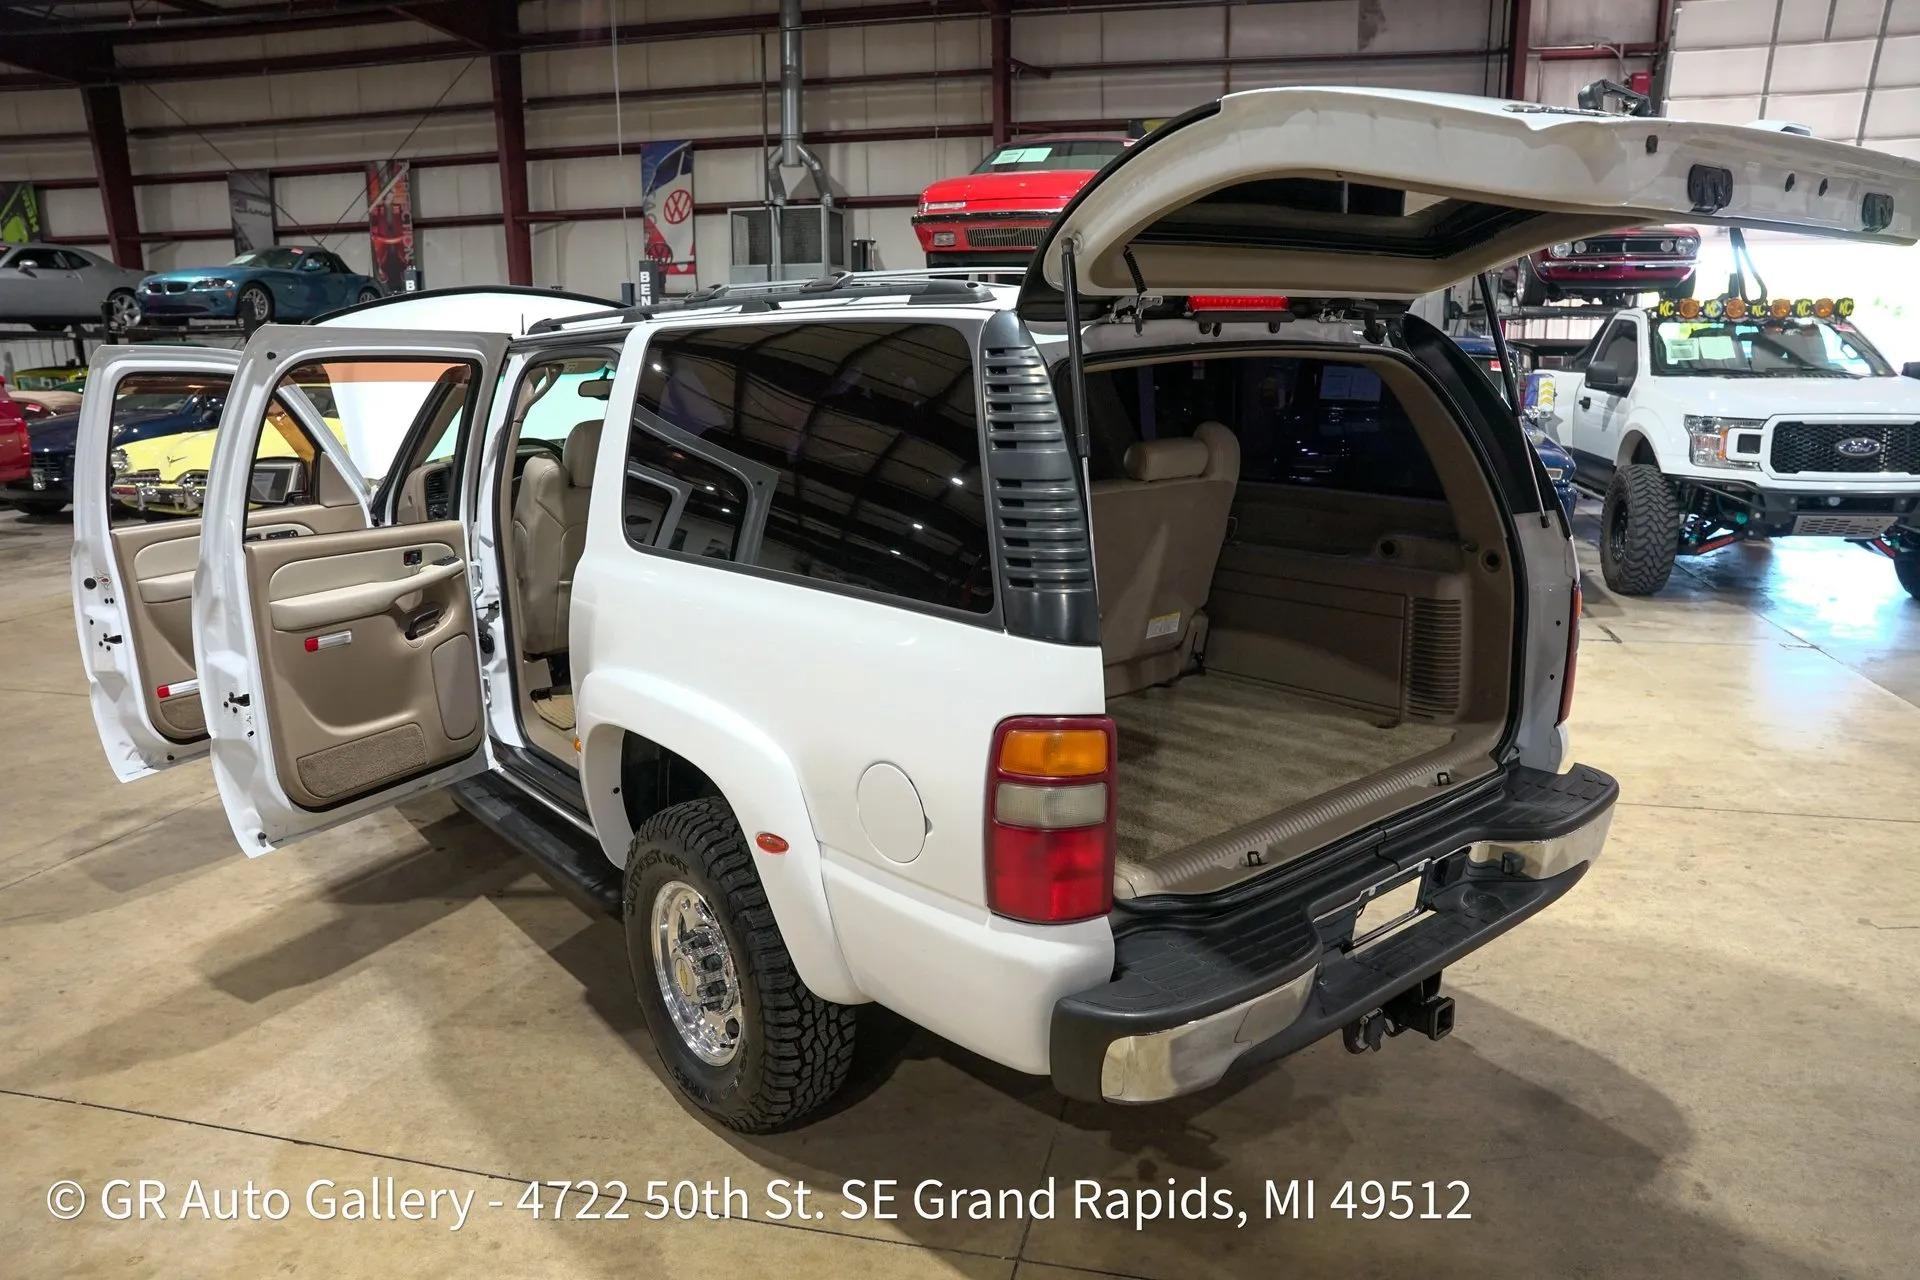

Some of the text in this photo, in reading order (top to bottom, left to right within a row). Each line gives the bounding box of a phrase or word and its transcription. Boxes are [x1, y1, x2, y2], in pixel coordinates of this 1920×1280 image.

[398, 160, 414, 260] PERFECTION
[1659, 301, 1674, 317] KC
[1797, 301, 1811, 315] KC
